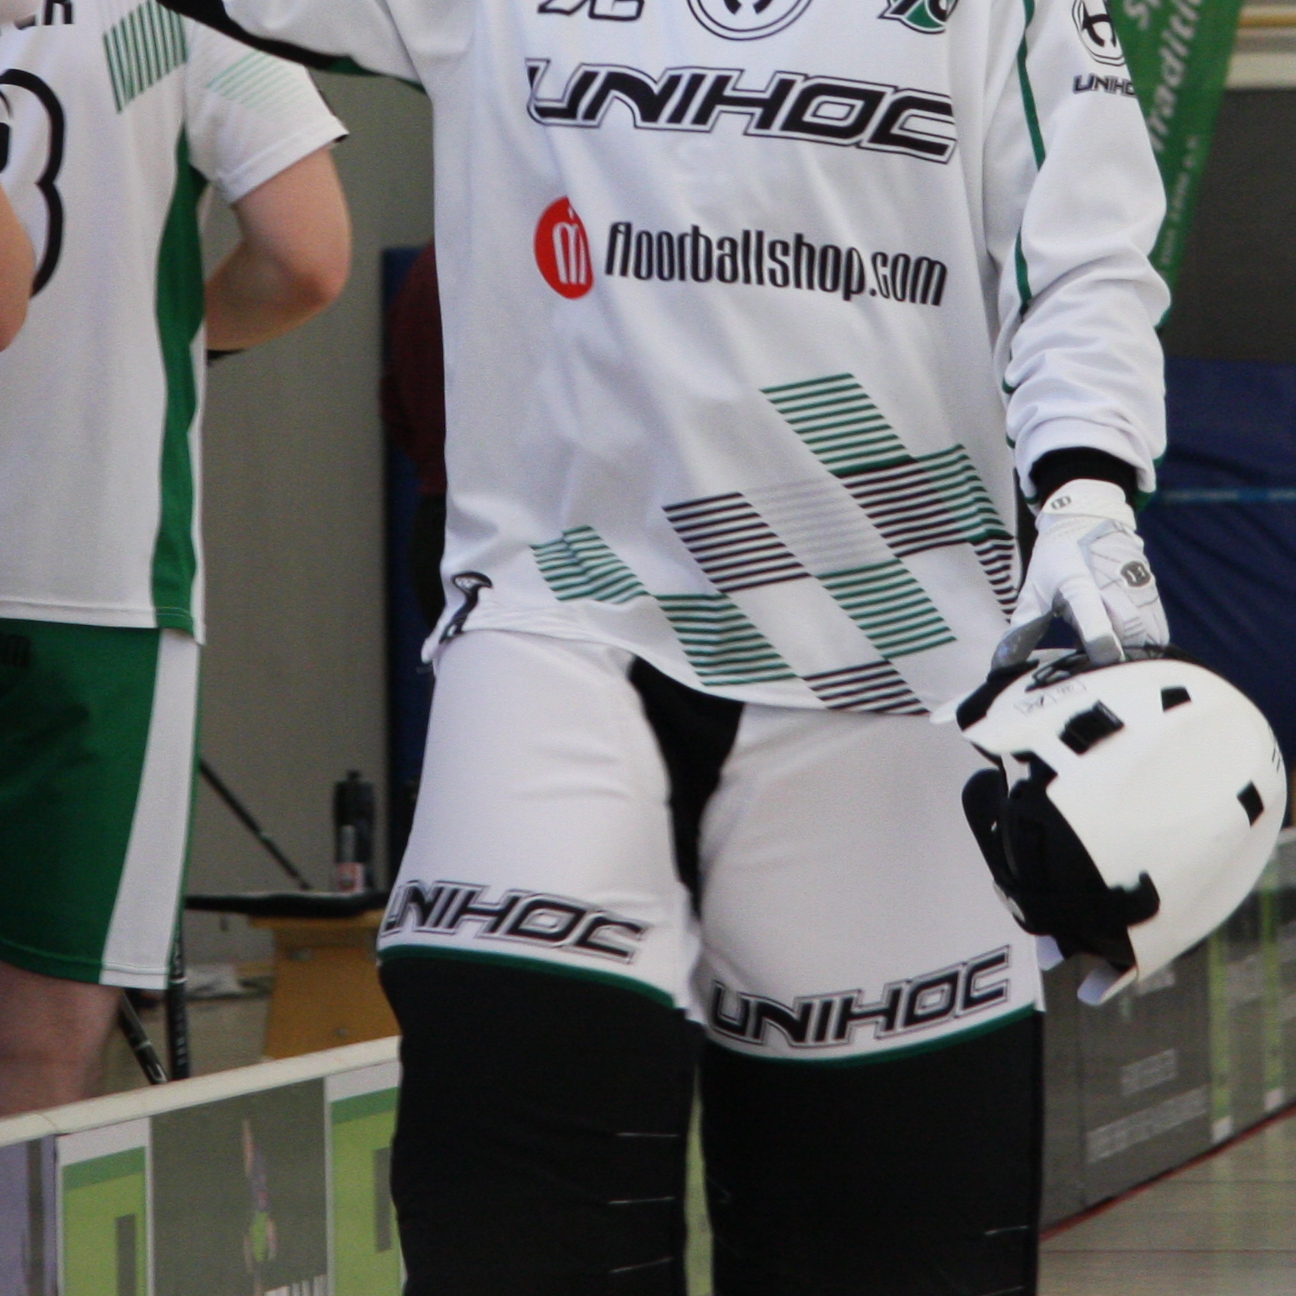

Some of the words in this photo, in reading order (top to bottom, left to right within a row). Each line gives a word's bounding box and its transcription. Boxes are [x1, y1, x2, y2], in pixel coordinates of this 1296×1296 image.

[525, 58, 958, 165] UNIHOC
[606, 221, 949, 307] floorballshop.com
[713, 944, 1011, 1049] UNIHOC
